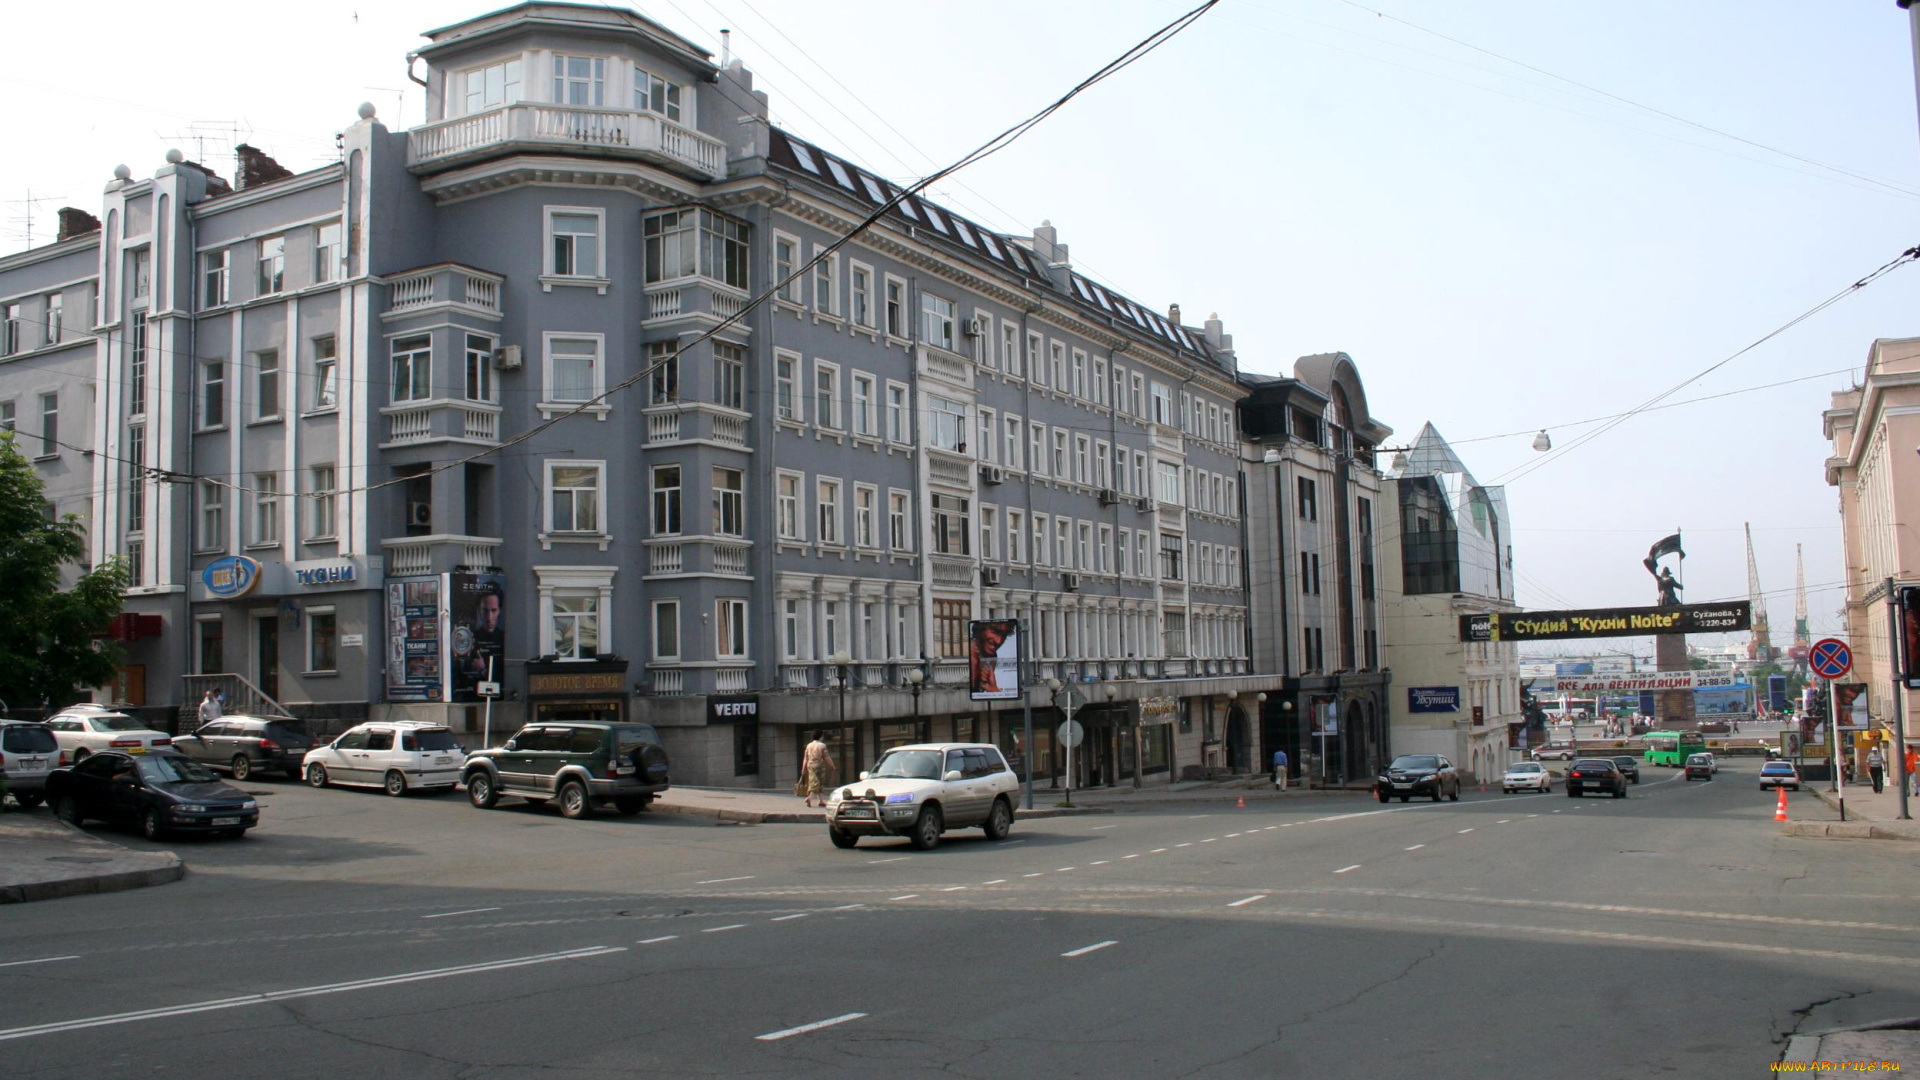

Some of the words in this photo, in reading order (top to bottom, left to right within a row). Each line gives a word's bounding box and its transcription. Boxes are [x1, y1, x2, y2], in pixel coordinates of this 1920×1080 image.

[1693, 610, 1735, 620] Суханова,
[1514, 620, 1568, 635] Студия
[537, 676, 581, 690] ЗОЛОТОЕ
[585, 675, 618, 689] ВРЕМЯ
[1557, 681, 1578, 690] ВСЕ
[1609, 677, 1691, 690] ВЕНТИЛЯЦИИ
[1697, 677, 1731, 686] 34-88-55
[1416, 695, 1454, 707] Якутии
[714, 703, 756, 716] VERTU
